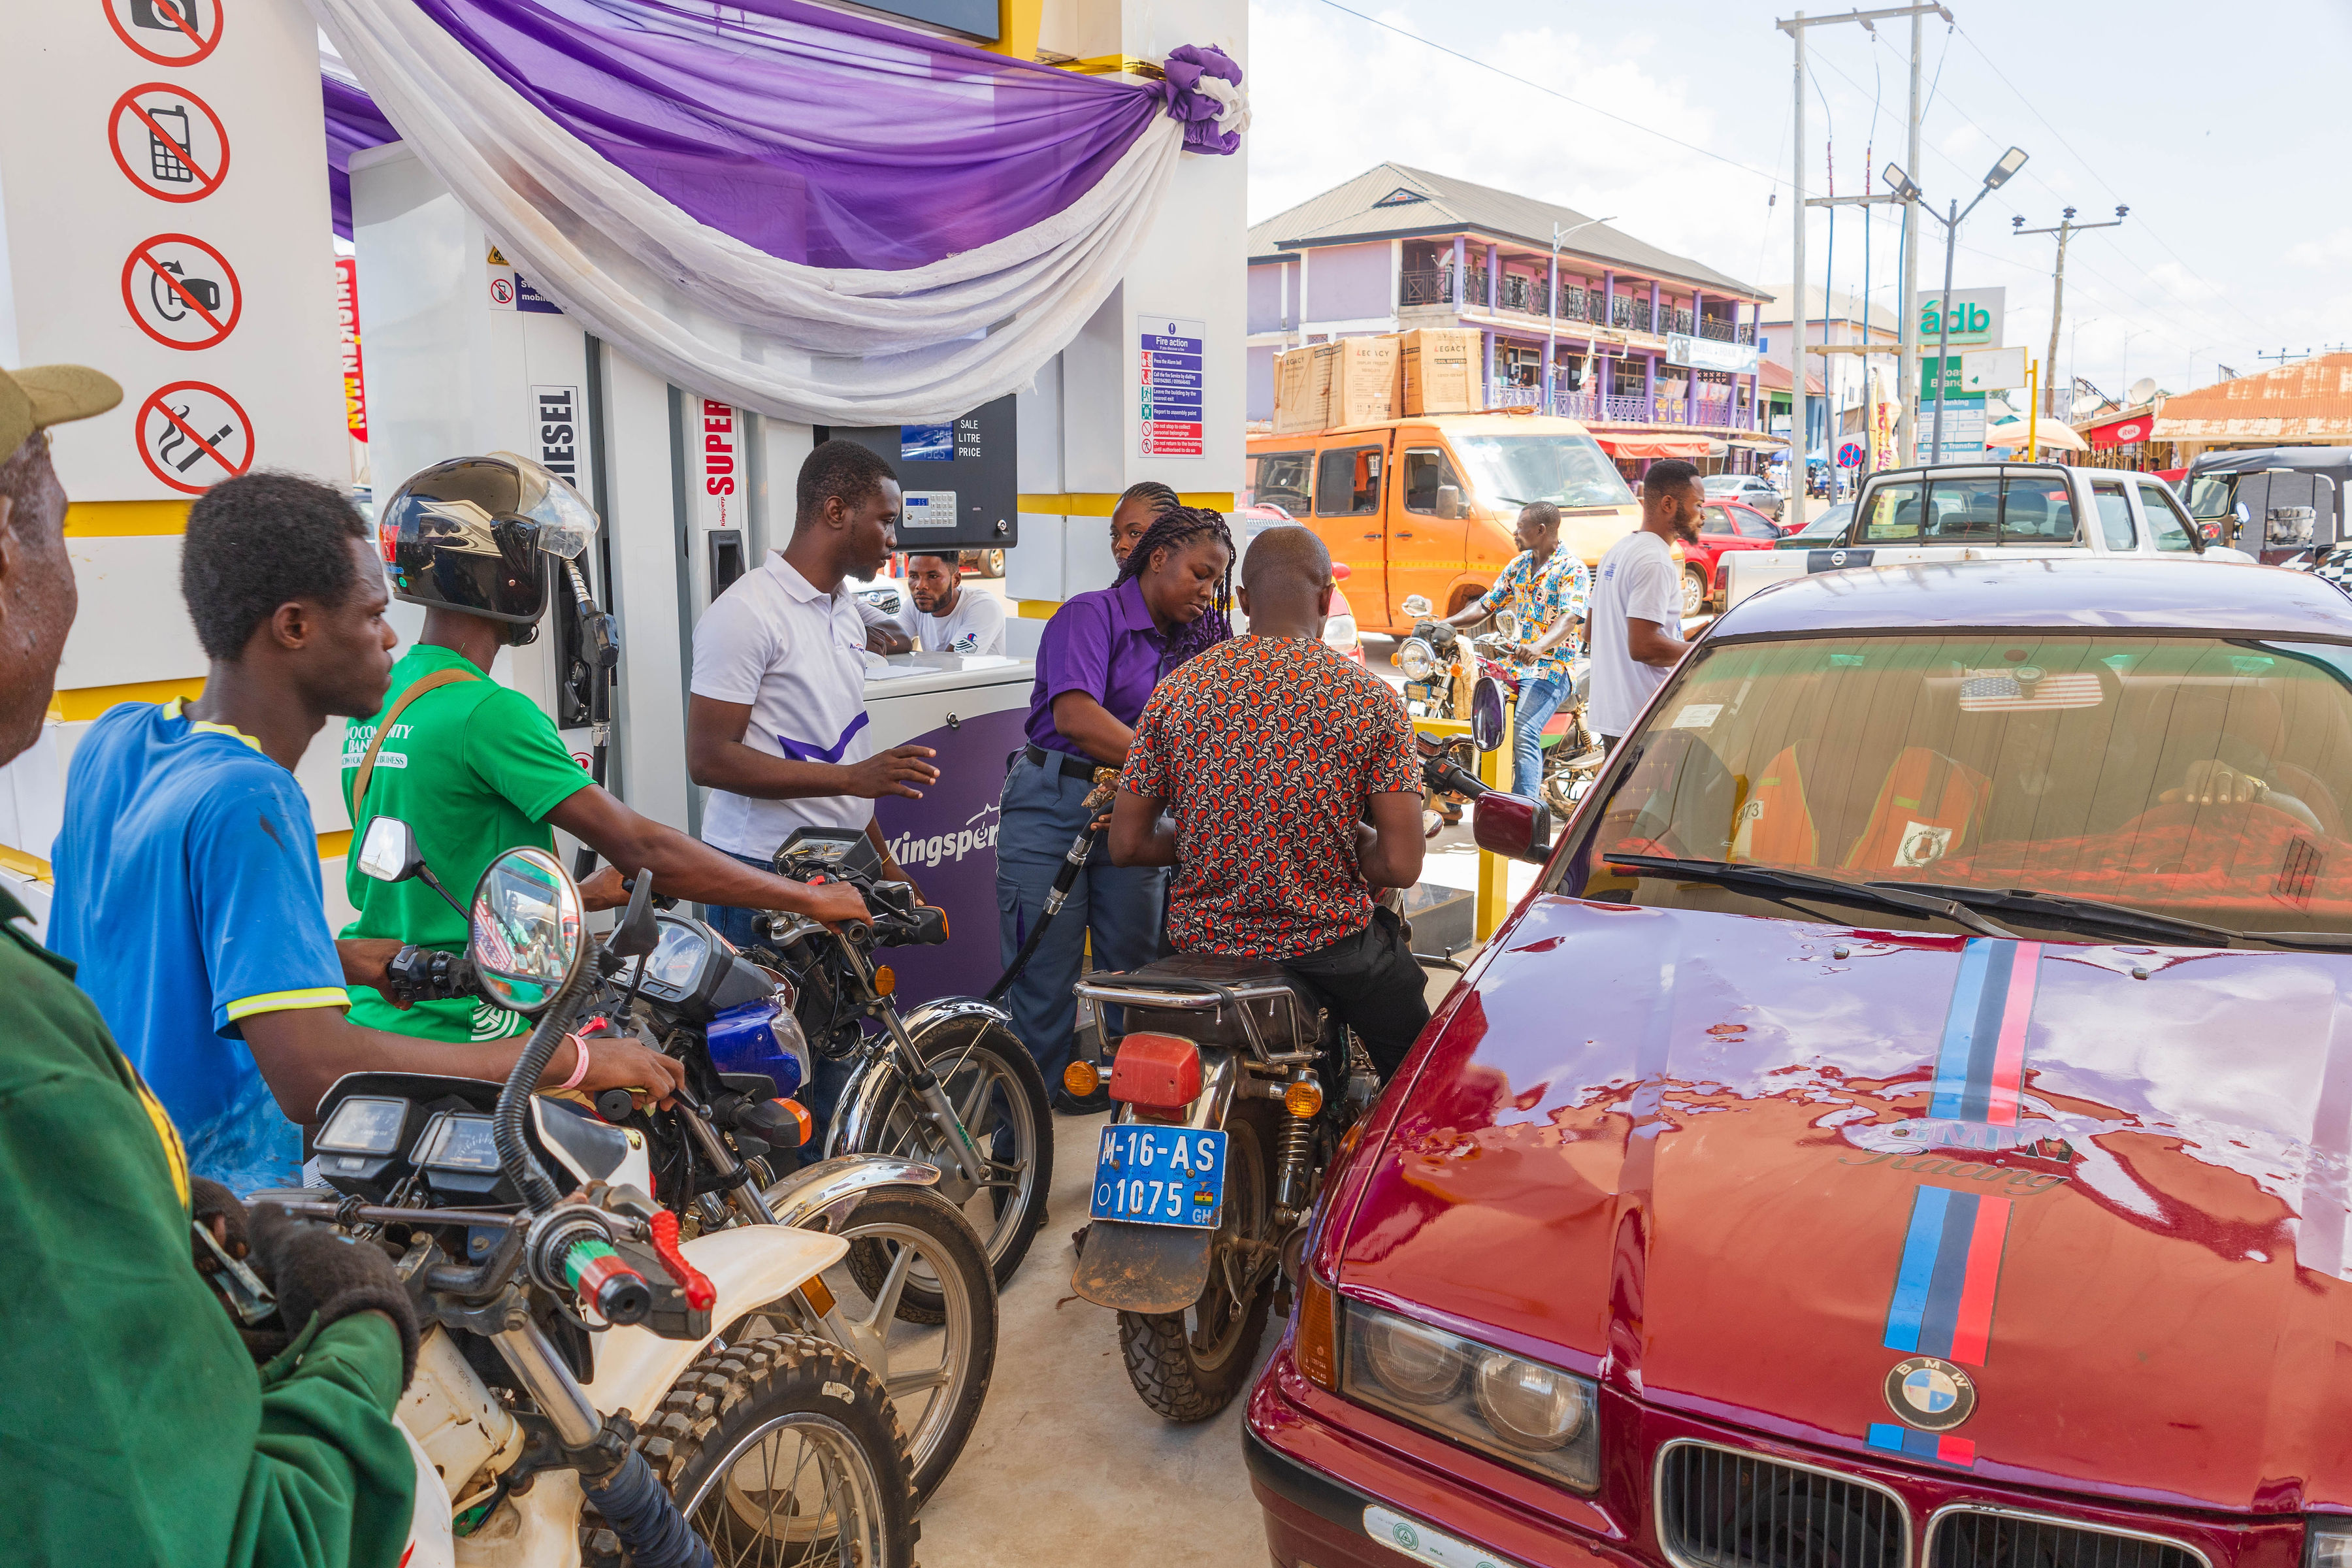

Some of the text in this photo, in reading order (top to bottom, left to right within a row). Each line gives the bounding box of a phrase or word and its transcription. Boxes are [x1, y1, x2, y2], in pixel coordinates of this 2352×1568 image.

[335, 266, 366, 429] CHICKEN MAN
[1156, 336, 1188, 347] Fire action
[1283, 357, 1304, 367] LEGACY
[1931, 378, 1962, 387] Banc
[960, 419, 978, 429] SALE
[958, 433, 981, 443] LITRE
[2122, 427, 2136, 436] itel
[704, 399, 734, 496] SUPER
[958, 448, 981, 457] PRICE
[358, 724, 414, 739] COMNITY
[1918, 830, 1939, 839] NADMO
[885, 825, 1000, 868] Kingsper
[1102, 1132, 1215, 1171] M-16-AS
[1838, 1143, 2072, 1195] Racing
[1117, 1179, 1183, 1217] 1075
[1192, 1208, 1212, 1224] GH
[1896, 1359, 1968, 1386] BMW
[1429, 1547, 1443, 1557] DVLA
